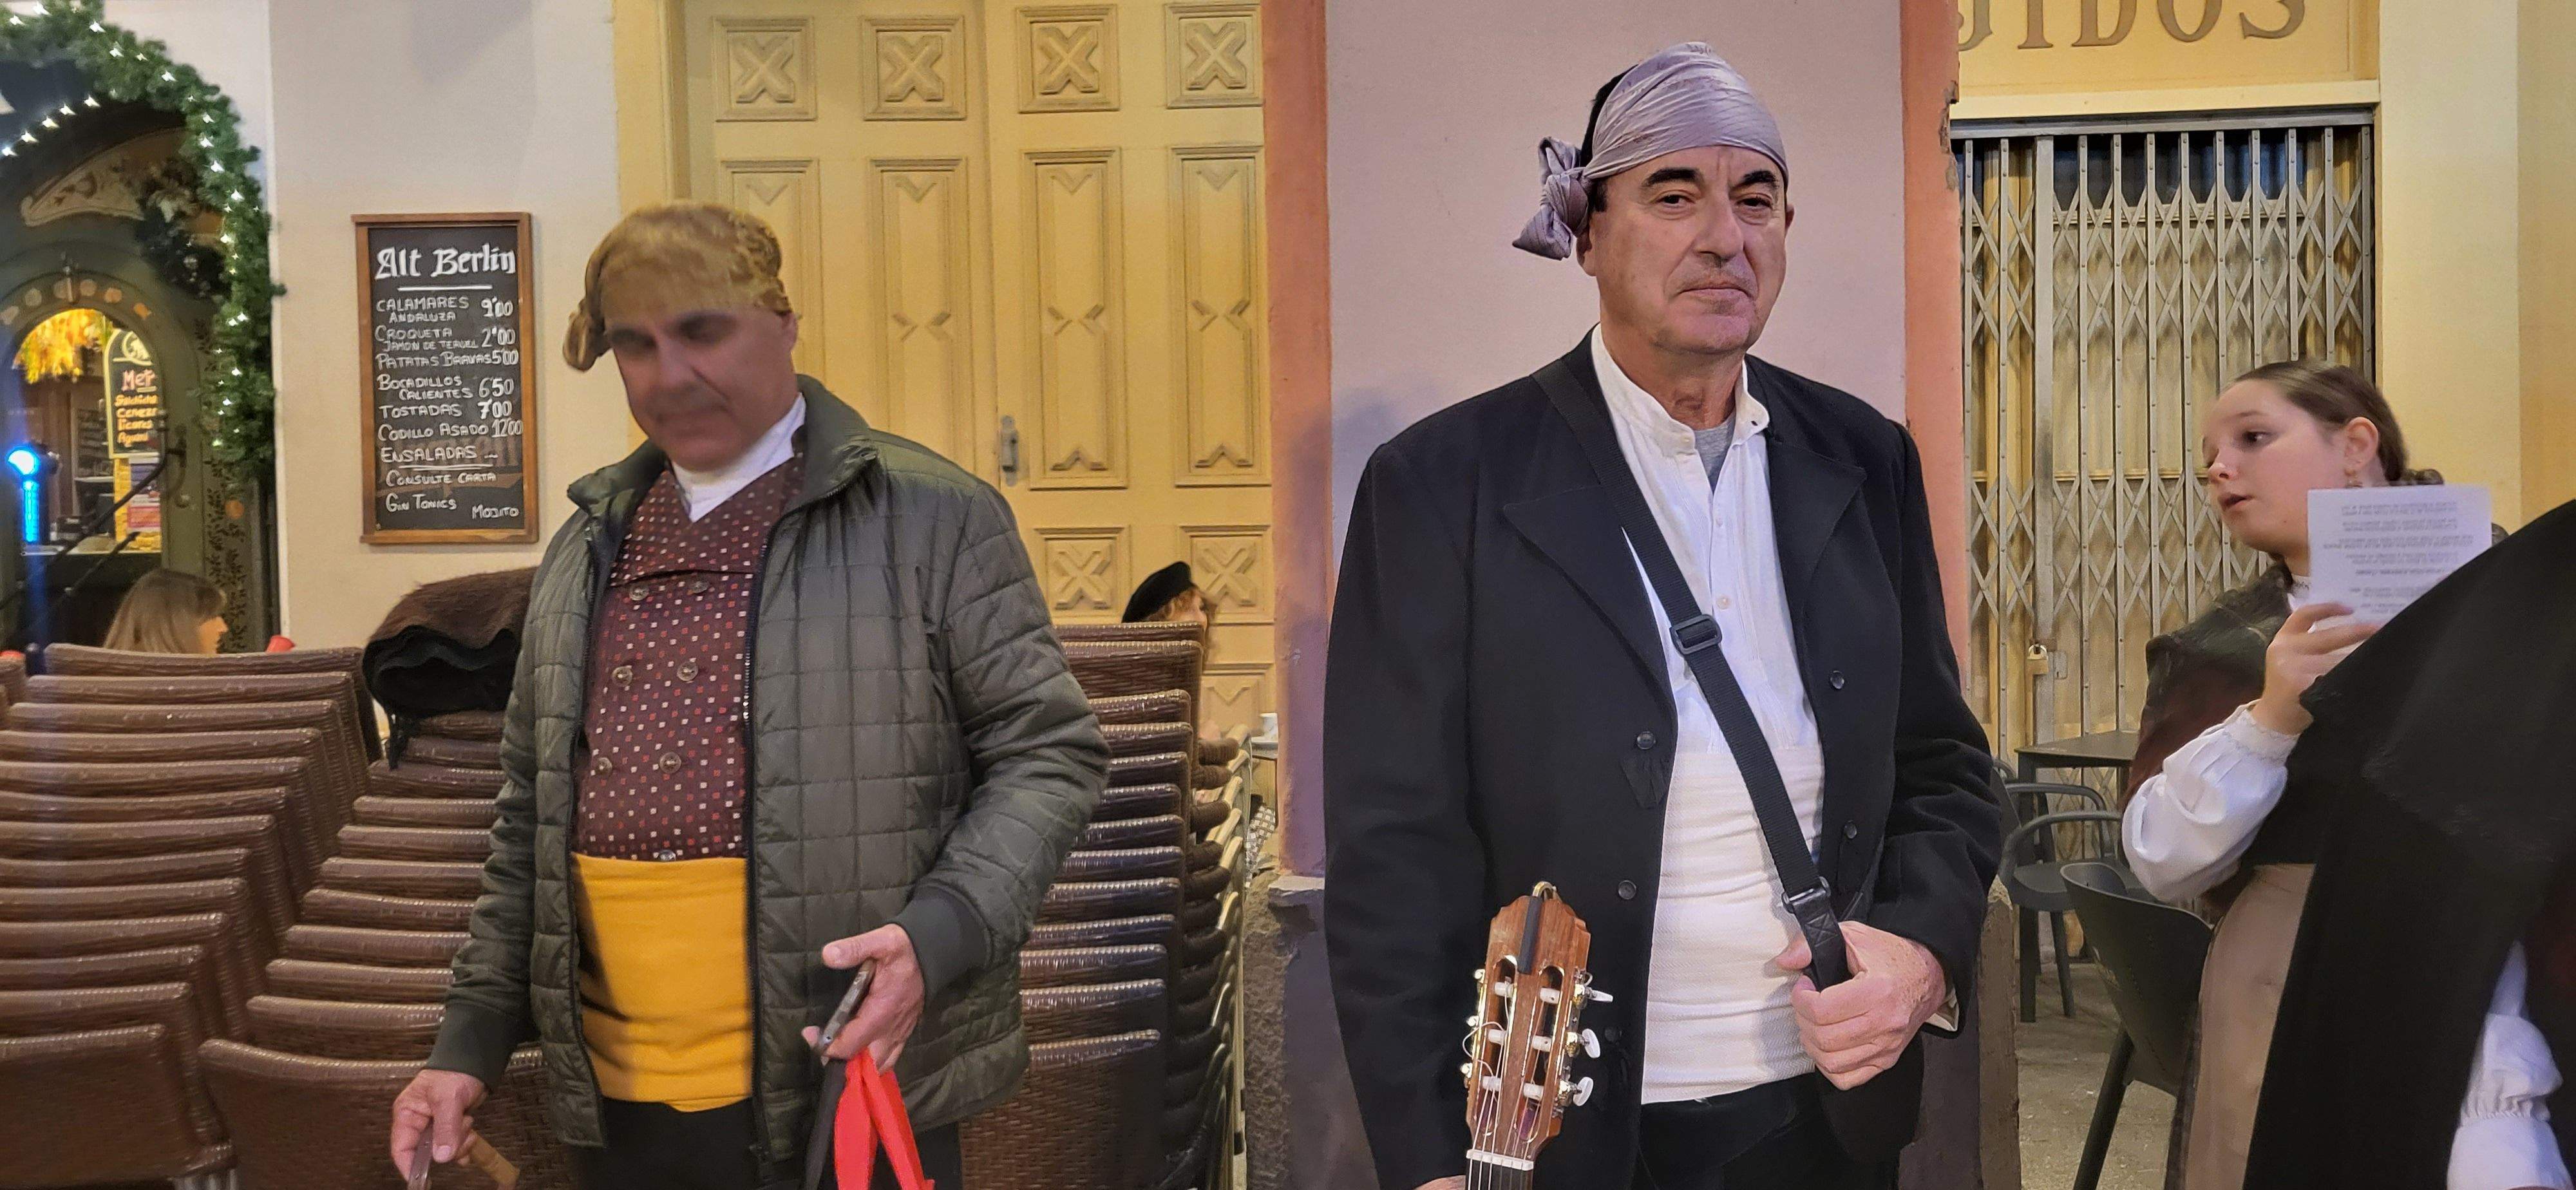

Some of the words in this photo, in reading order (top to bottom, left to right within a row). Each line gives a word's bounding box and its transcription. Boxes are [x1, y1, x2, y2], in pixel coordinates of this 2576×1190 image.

[375, 247, 421, 280] Alt
[430, 243, 516, 277] Berlin
[376, 296, 469, 312] CALAMARES
[389, 311, 456, 323] ANDALUZA
[375, 325, 453, 341] CROQUETA
[382, 340, 420, 352] JAMON
[422, 340, 437, 350] DE
[439, 339, 478, 350] TERUEL
[375, 353, 439, 370] PATATAS
[440, 351, 492, 367] BRAVAS
[377, 373, 462, 390] BOCADILLOS
[399, 388, 473, 401] CALIENTES
[378, 404, 462, 419] TOSTADAS
[378, 424, 433, 441] CODILLO
[439, 422, 489, 437] ASADO
[381, 446, 477, 463] ENSALADAS
[386, 470, 453, 487] CONSULTE
[458, 473, 497, 484] CARTA
[413, 494, 457, 510] TONICS
[472, 504, 519, 519] MOJITO
